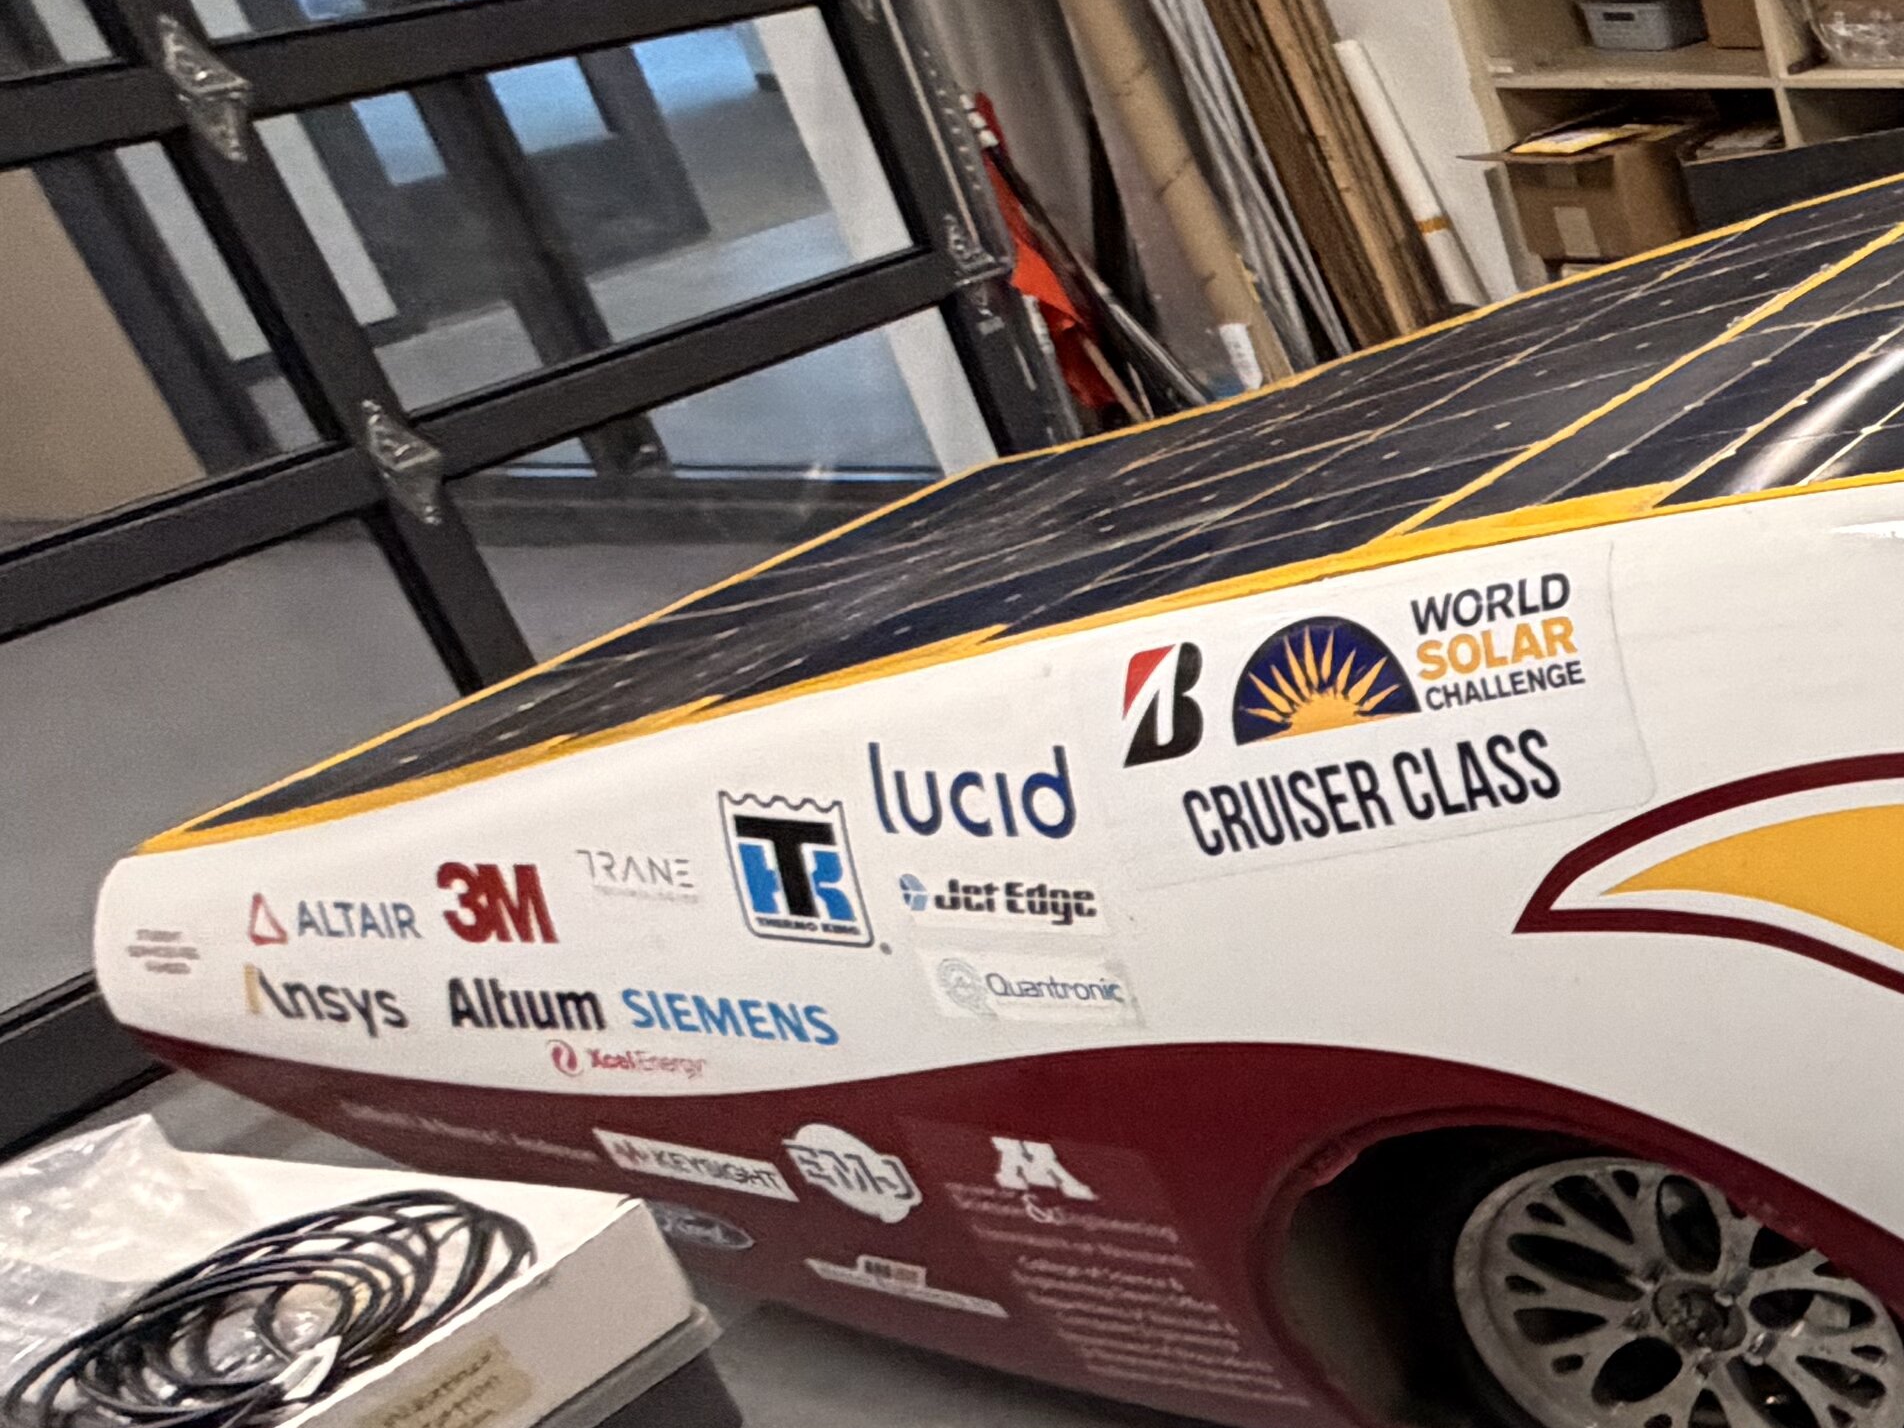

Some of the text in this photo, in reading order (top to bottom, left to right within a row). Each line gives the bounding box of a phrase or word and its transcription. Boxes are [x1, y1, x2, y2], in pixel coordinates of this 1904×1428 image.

[1410, 571, 1571, 637] WORLD
[1416, 615, 1579, 682] SOLAR
[1424, 659, 1586, 713] CHALLENGE
[868, 741, 1077, 840] lucid
[1181, 727, 1562, 858] CRUISER CLASS
[575, 848, 695, 889] TRANE
[297, 900, 423, 939] ALTAIR
[435, 861, 560, 944] 3M
[934, 878, 1097, 926] Jet Edge
[447, 976, 608, 1031] Altium
[621, 987, 840, 1046] SIEMENS
[652, 1150, 782, 1191] KEYSIGHT
